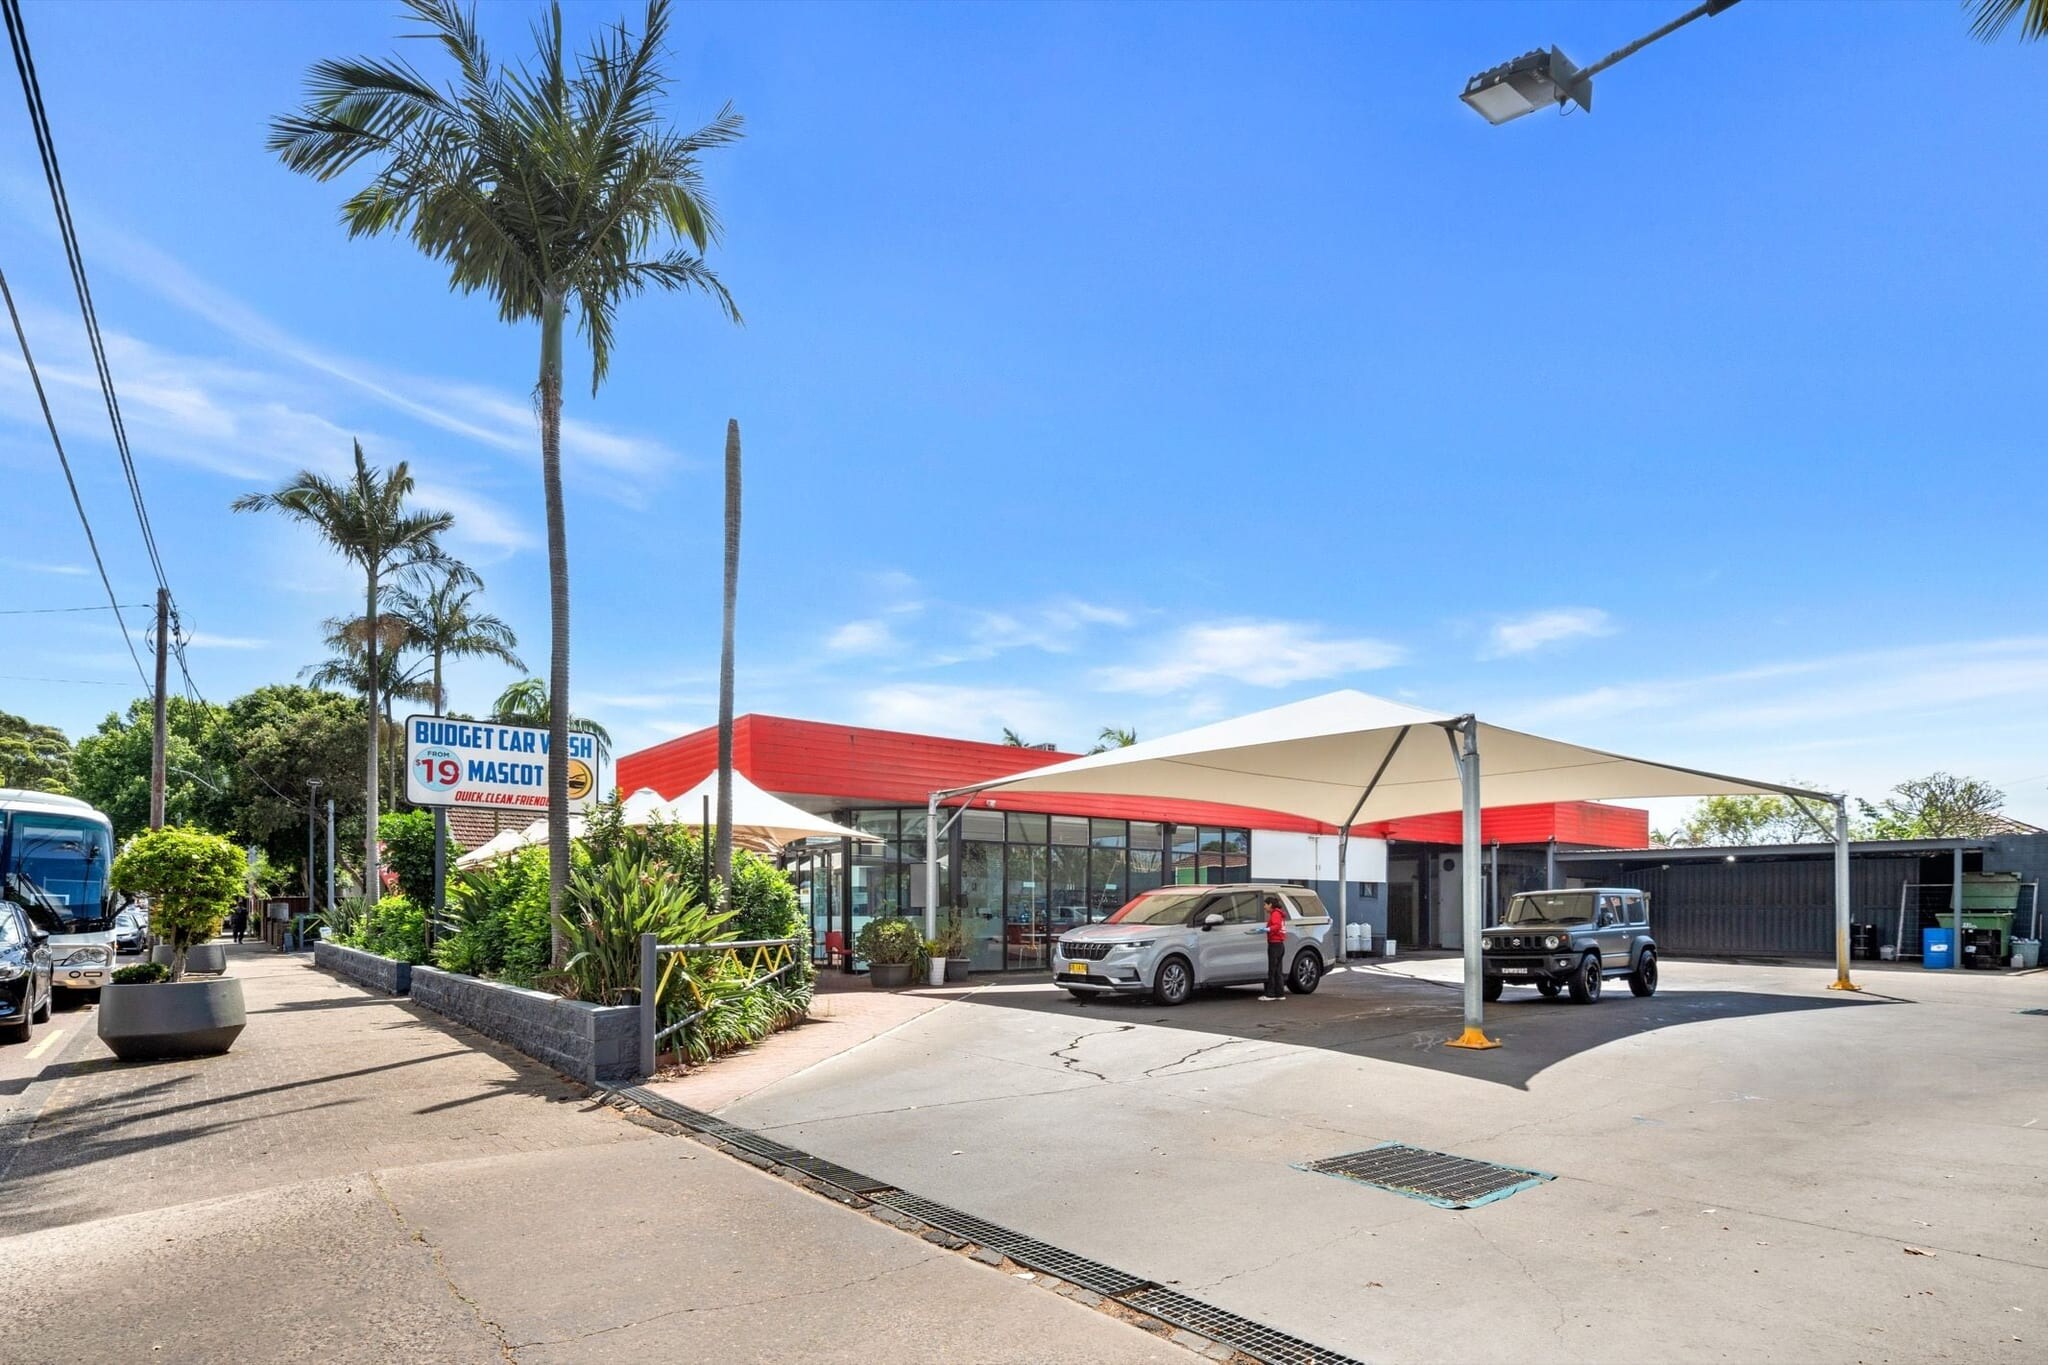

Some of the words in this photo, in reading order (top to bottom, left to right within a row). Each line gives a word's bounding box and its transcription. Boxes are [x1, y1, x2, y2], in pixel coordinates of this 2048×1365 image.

[415, 720, 494, 749] BUDGET
[499, 729, 535, 753] CAR
[540, 733, 592, 758] WSH
[427, 750, 450, 758] FROM
[415, 758, 459, 785] $19
[468, 759, 544, 786] MASCOT
